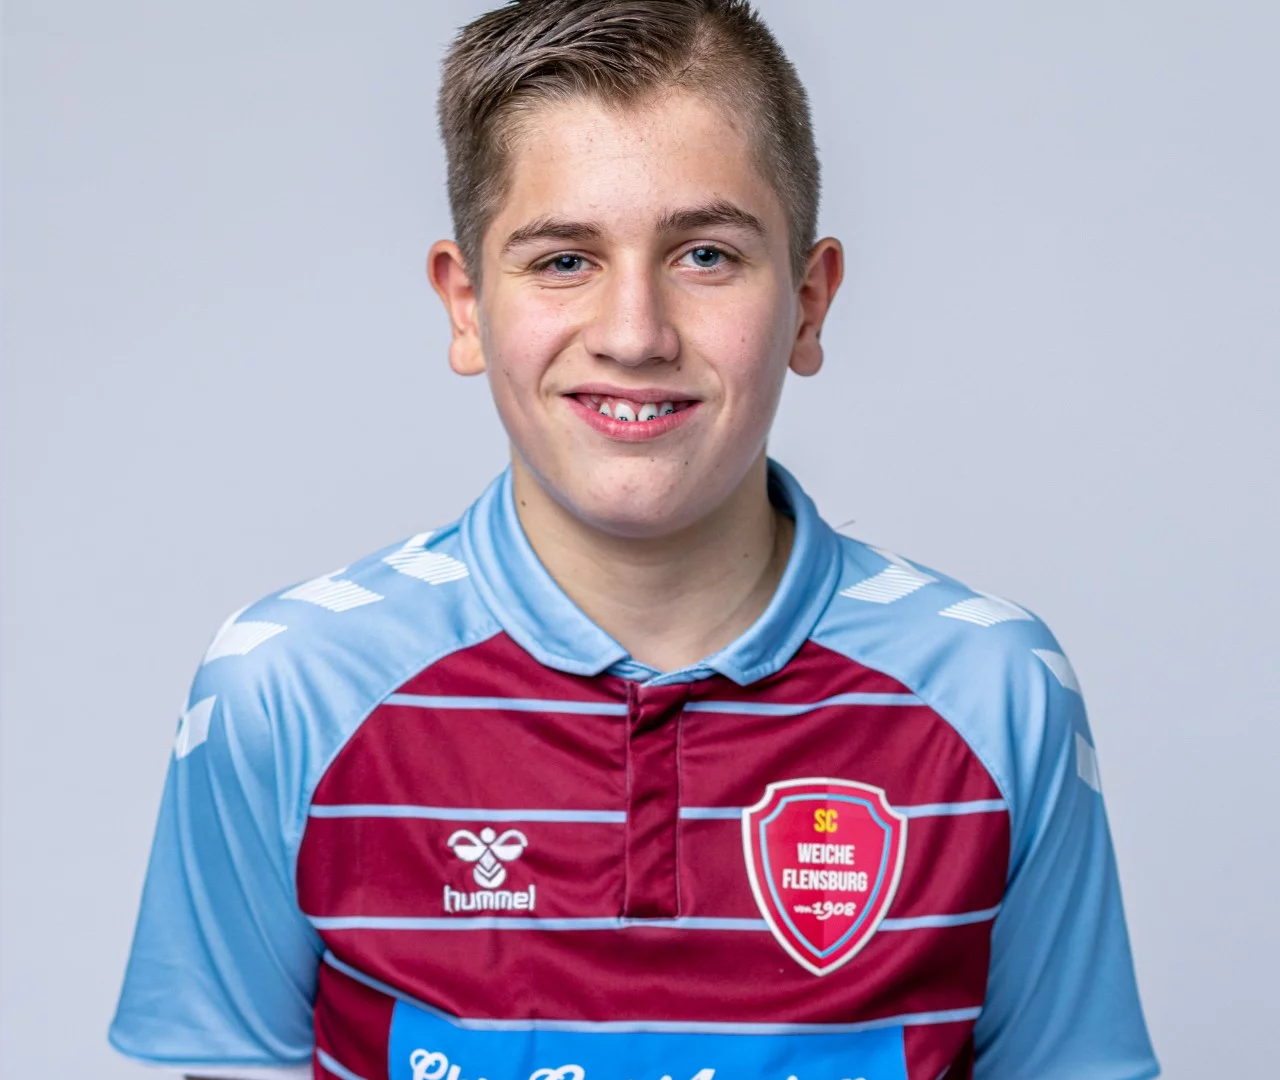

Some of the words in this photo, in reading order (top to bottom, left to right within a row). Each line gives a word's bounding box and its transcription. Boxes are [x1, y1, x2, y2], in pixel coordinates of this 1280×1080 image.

[814, 808, 838, 833] SC
[797, 842, 855, 865] WEICHE
[782, 868, 868, 892] FLENSBURG
[443, 884, 536, 913] hummel
[812, 900, 857, 921] 1908
